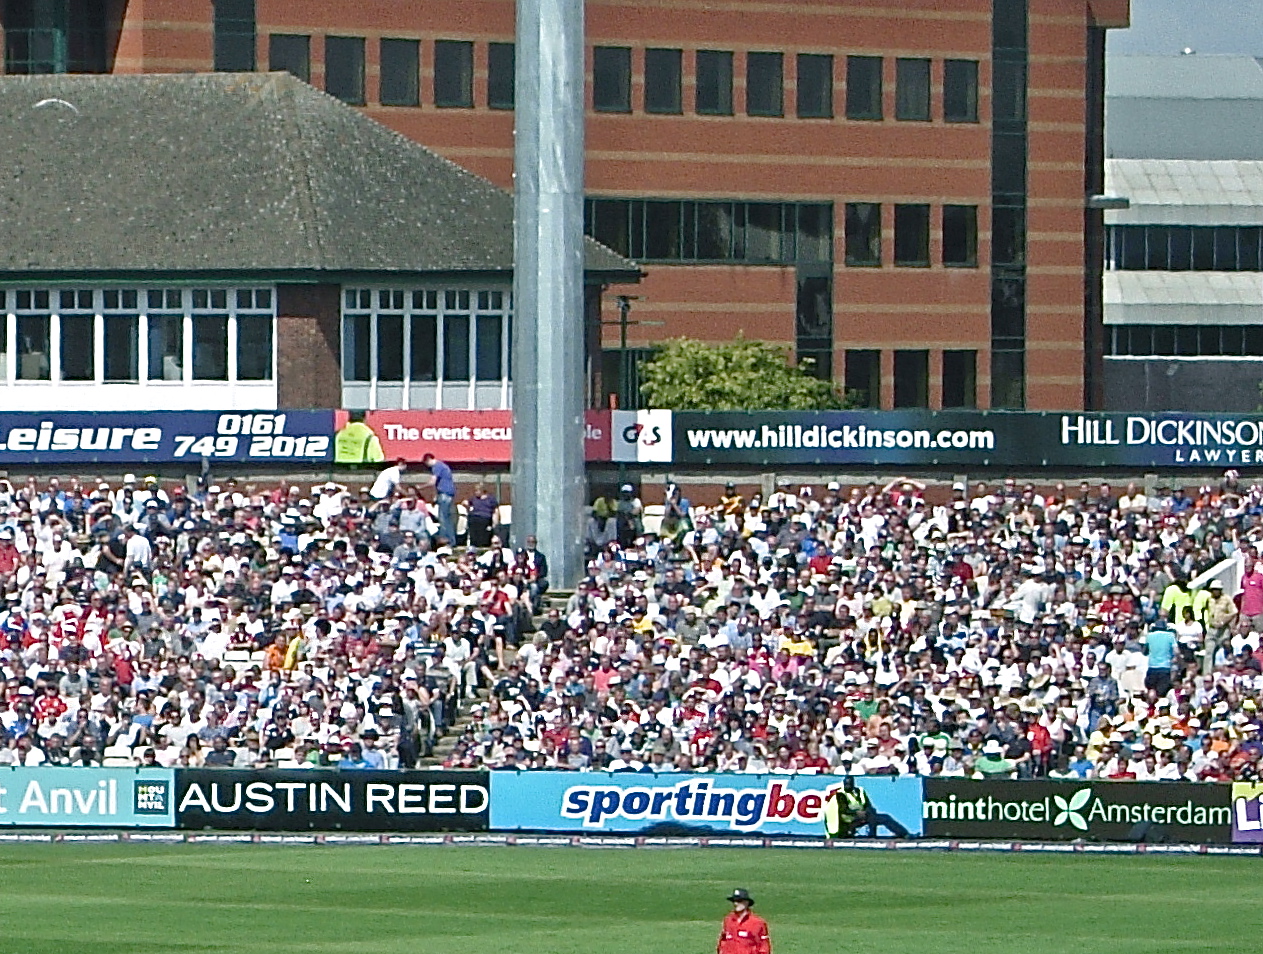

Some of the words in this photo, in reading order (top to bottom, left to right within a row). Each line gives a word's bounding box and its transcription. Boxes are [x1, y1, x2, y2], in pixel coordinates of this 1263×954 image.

[217, 414, 286, 435] 0161
[383, 424, 419, 440] The
[422, 425, 471, 440] event
[473, 427, 512, 440] secu
[623, 423, 661, 446] G4S
[687, 425, 994, 448] www.hilldickinson.com
[1061, 416, 1119, 445] HILL
[173, 436, 238, 457] 749
[248, 436, 329, 457] 2012
[18, 780, 117, 814] Anvil
[179, 783, 350, 813] AUSTIN
[366, 784, 488, 814] REED
[565, 783, 841, 826] sportingbe
[923, 795, 1049, 823] minthotel
[1088, 798, 1231, 825] Amsterdam
